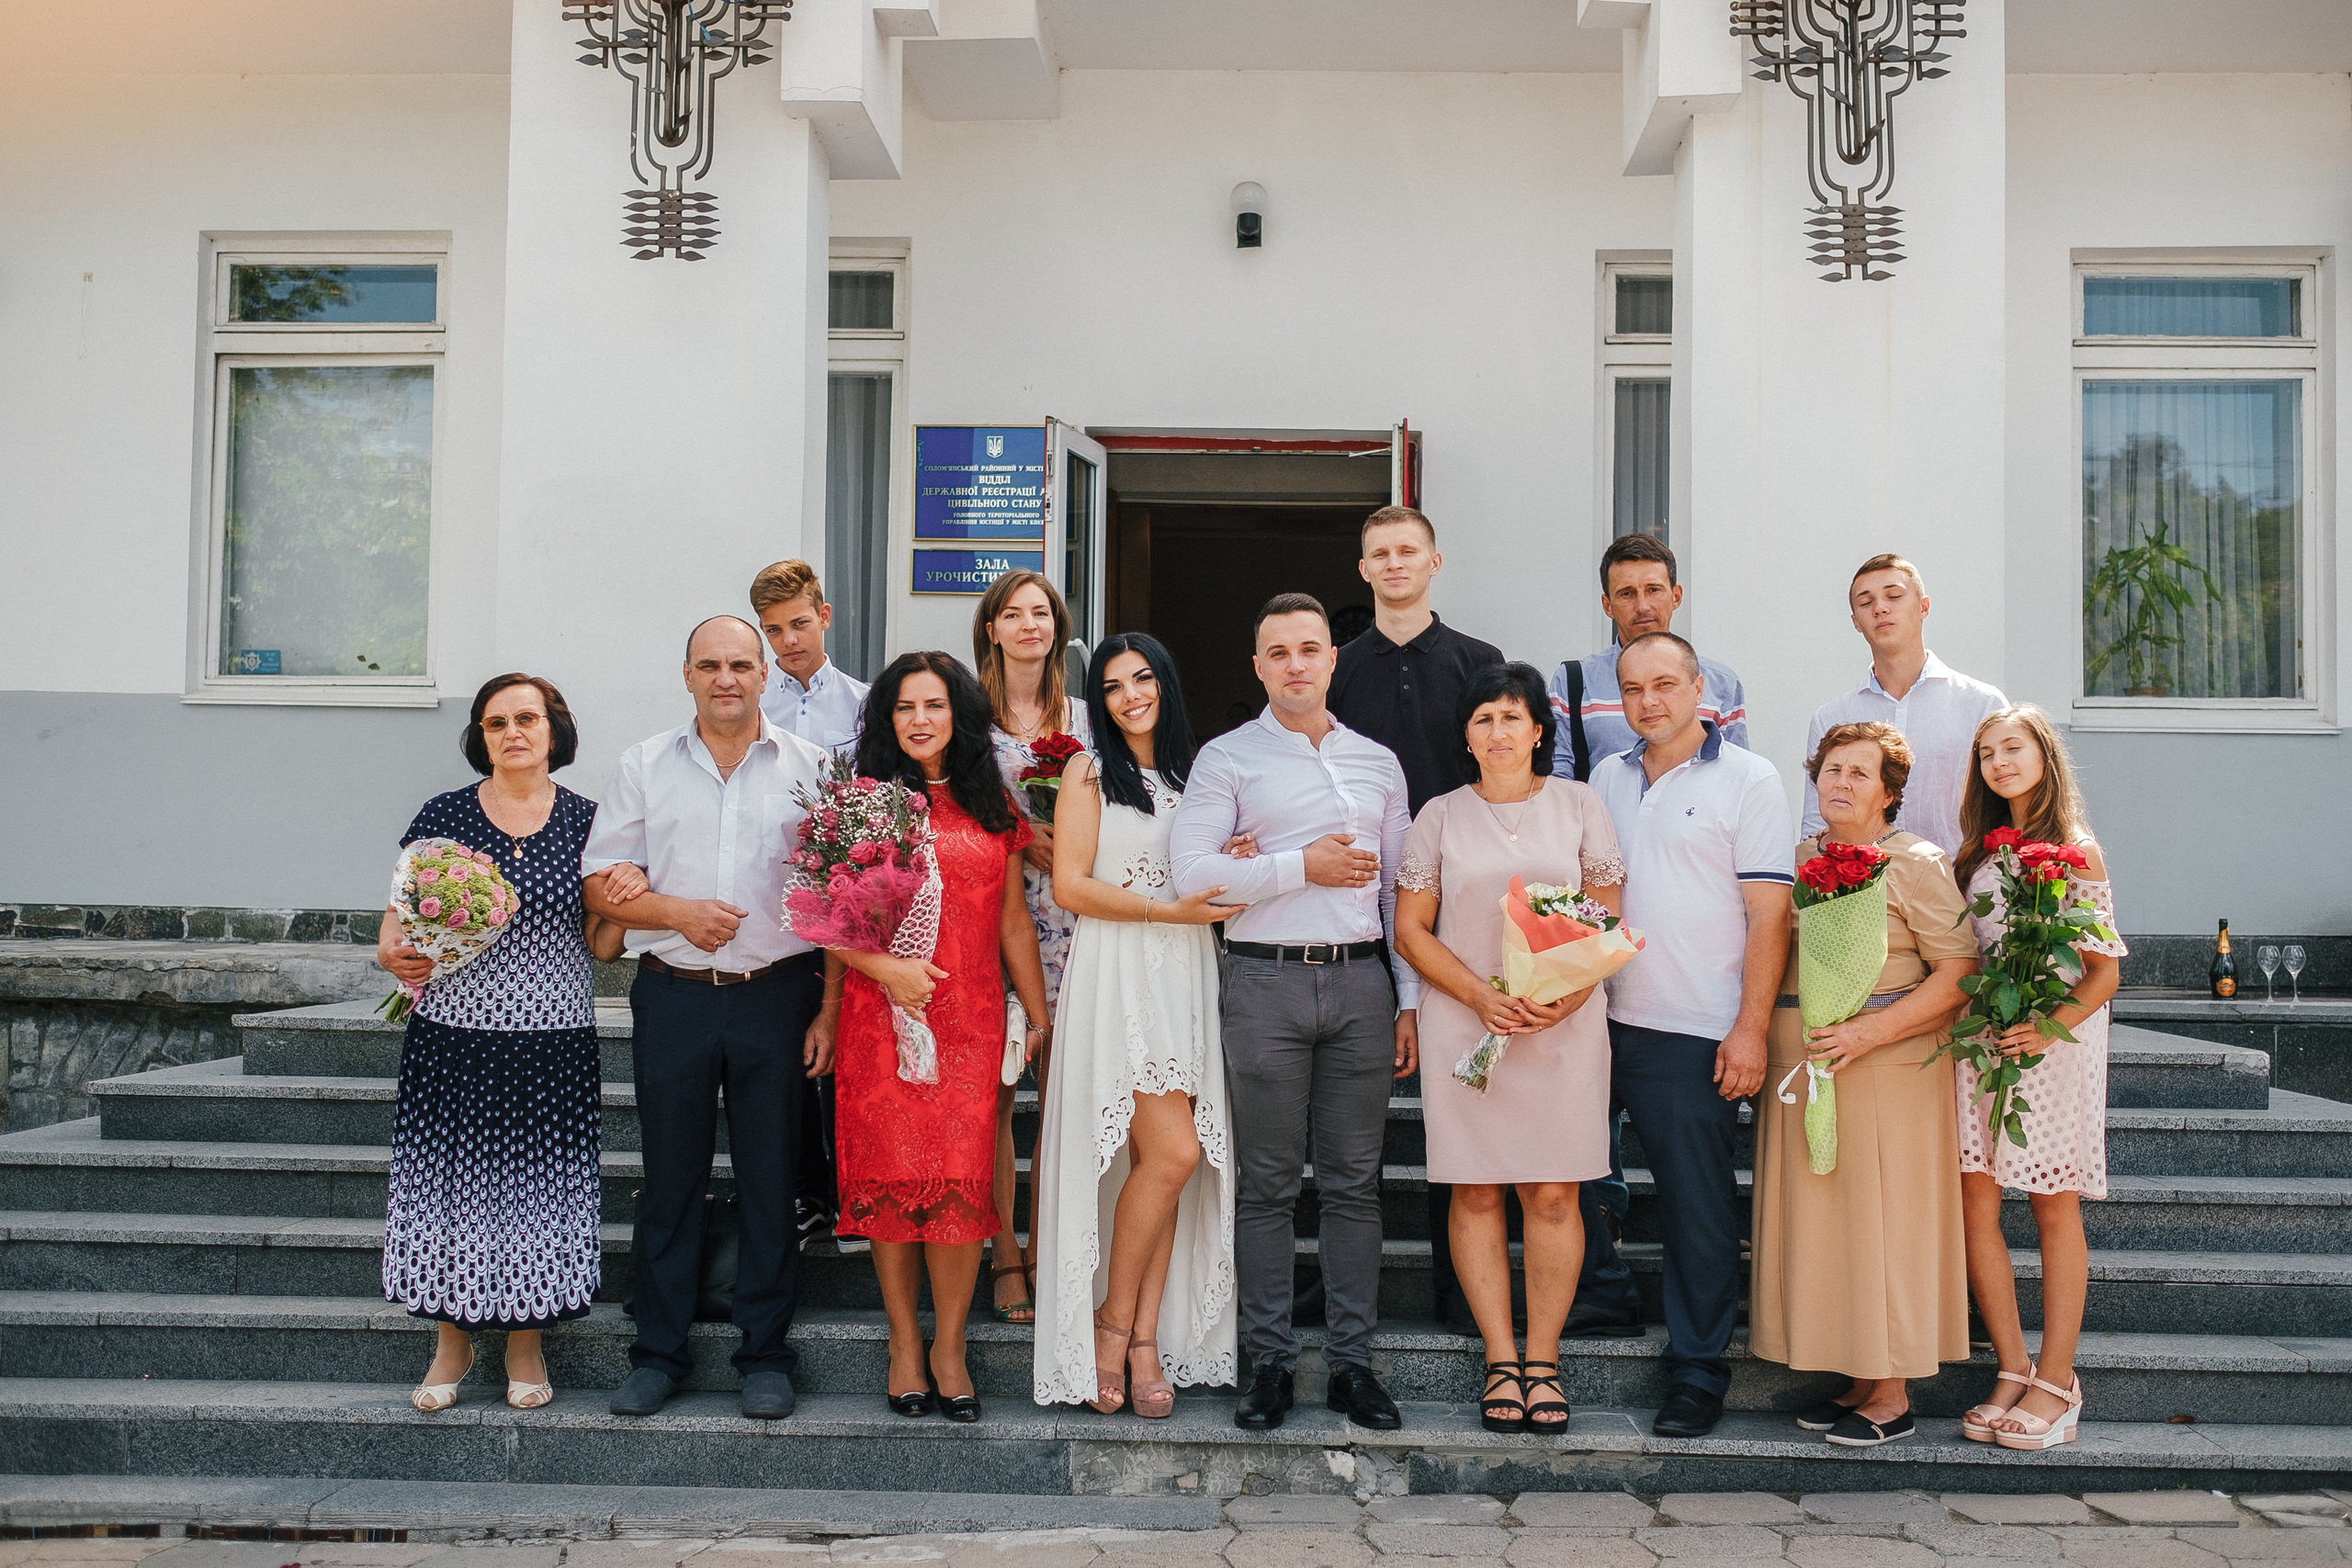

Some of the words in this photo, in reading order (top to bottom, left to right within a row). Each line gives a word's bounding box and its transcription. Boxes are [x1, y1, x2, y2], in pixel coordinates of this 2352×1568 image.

[978, 475, 1012, 485] ВІДДІЛ
[922, 486, 978, 497] ДЕРЖАВНОЇ
[981, 486, 1036, 497] РЕЄСТРАЦІЇ
[947, 499, 1009, 509] ЦИВІЛЬНОГО
[1012, 499, 1042, 508] СТАНУ
[975, 558, 1011, 570] ЗАЛА
